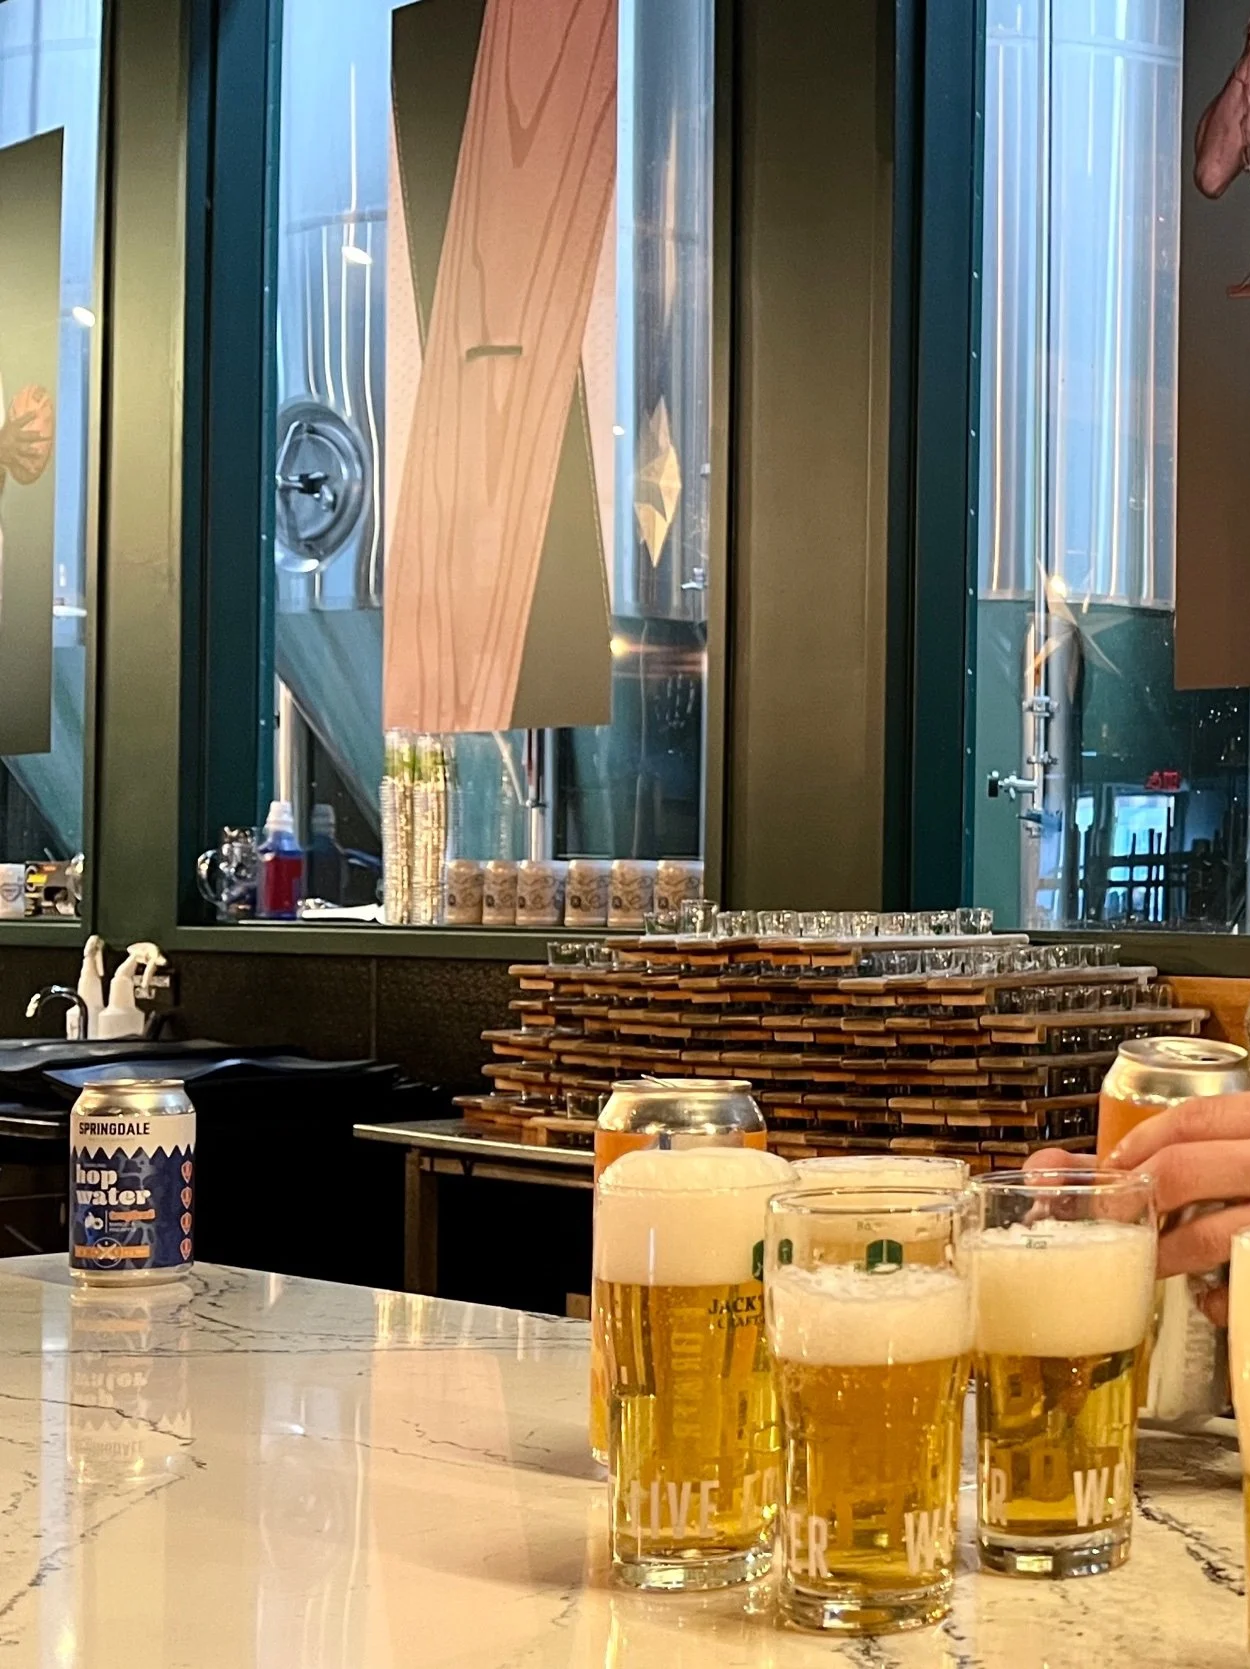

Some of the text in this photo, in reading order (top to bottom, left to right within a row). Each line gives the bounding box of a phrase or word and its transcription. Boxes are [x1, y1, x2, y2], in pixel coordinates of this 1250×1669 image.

[79, 1122, 150, 1135] SPRINGDALE
[76, 1163, 118, 1190] hop
[76, 1187, 152, 1206] water
[628, 1479, 719, 1539] LIVE
